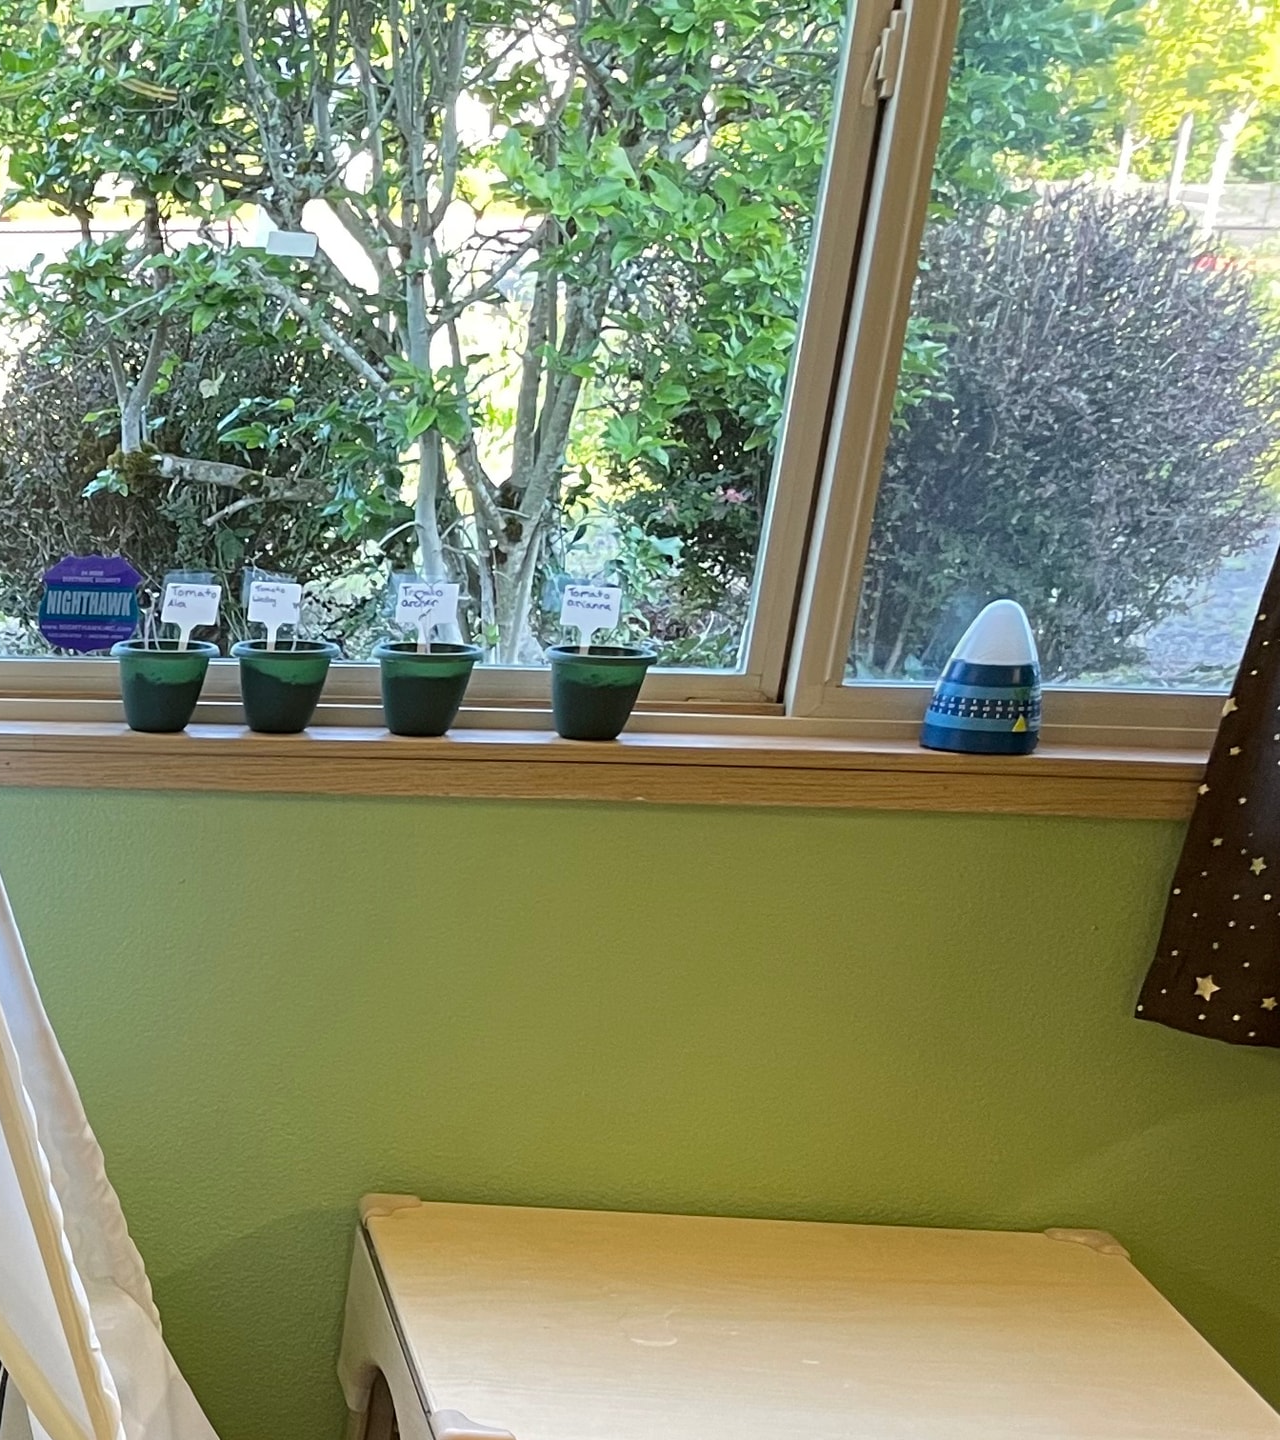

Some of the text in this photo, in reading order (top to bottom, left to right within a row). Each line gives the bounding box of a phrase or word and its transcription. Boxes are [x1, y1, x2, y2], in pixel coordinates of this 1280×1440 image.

[170, 585, 217, 599] Tomato
[568, 587, 610, 600] Tomato
[46, 589, 133, 617] NIGHTHAWK
